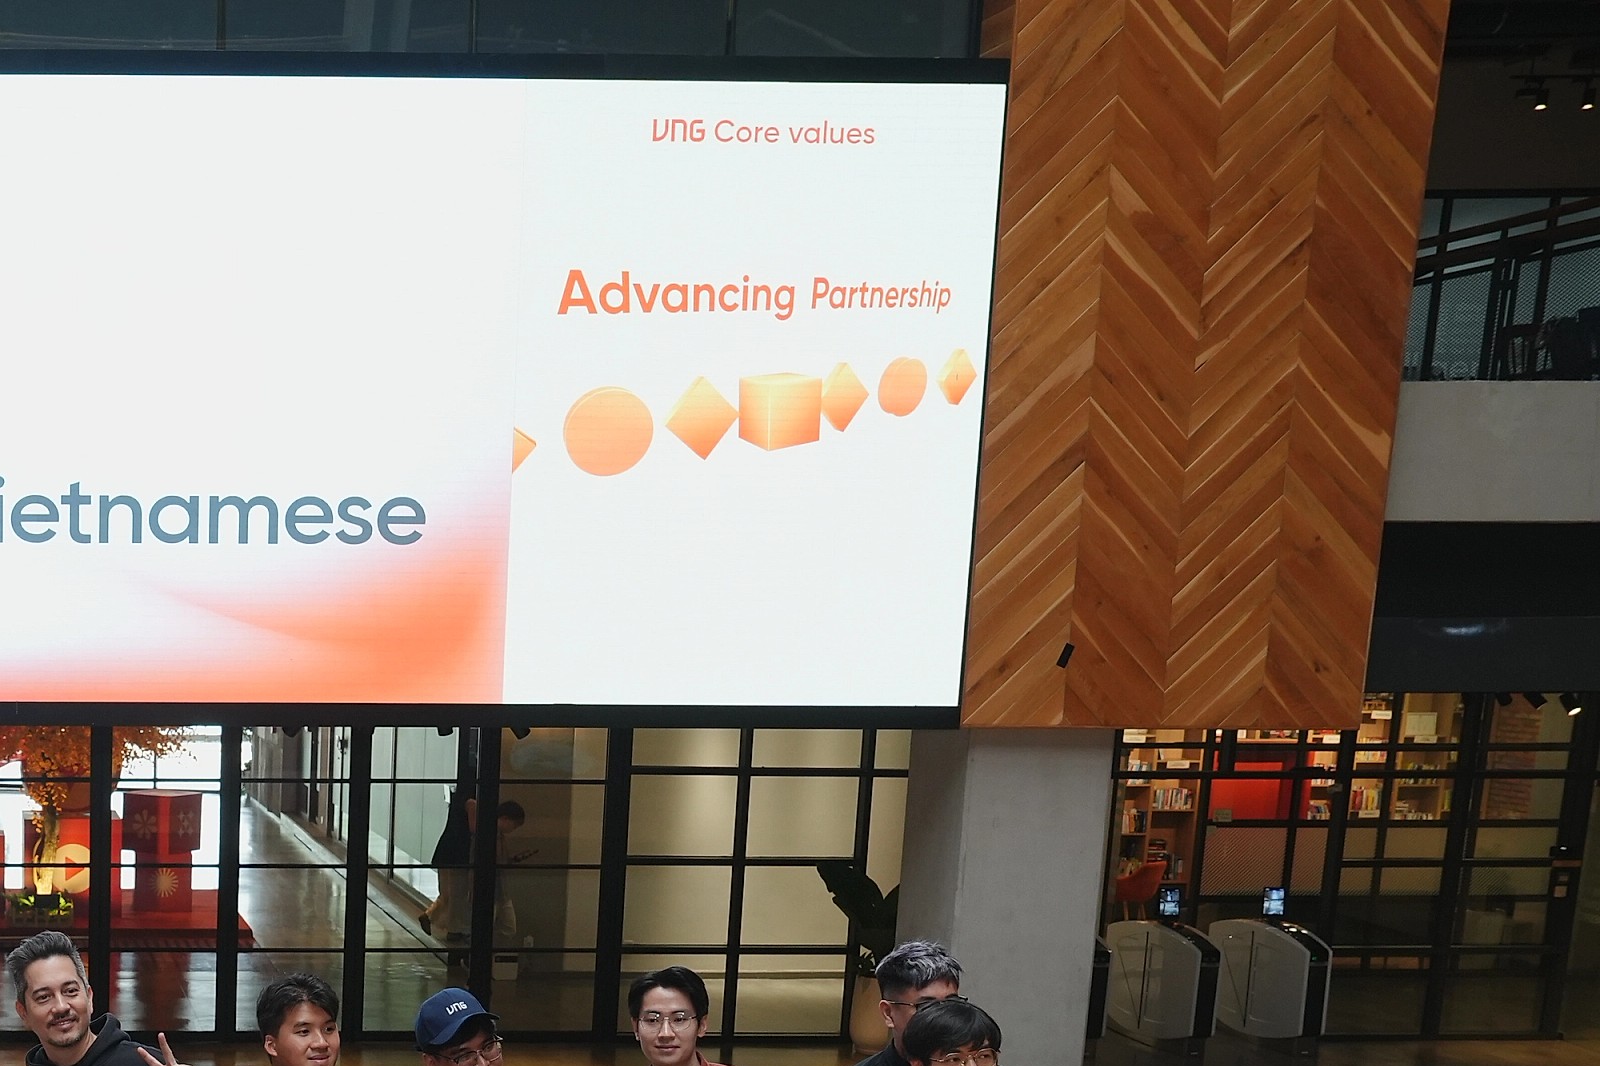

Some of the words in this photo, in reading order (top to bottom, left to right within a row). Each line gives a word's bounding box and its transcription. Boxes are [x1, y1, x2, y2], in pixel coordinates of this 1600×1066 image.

[652, 119, 706, 143] VNG
[714, 120, 781, 144] Core
[789, 121, 876, 145] values
[557, 269, 796, 321] Advancing
[811, 276, 953, 315] Partnership
[445, 1001, 468, 1016] VNG
